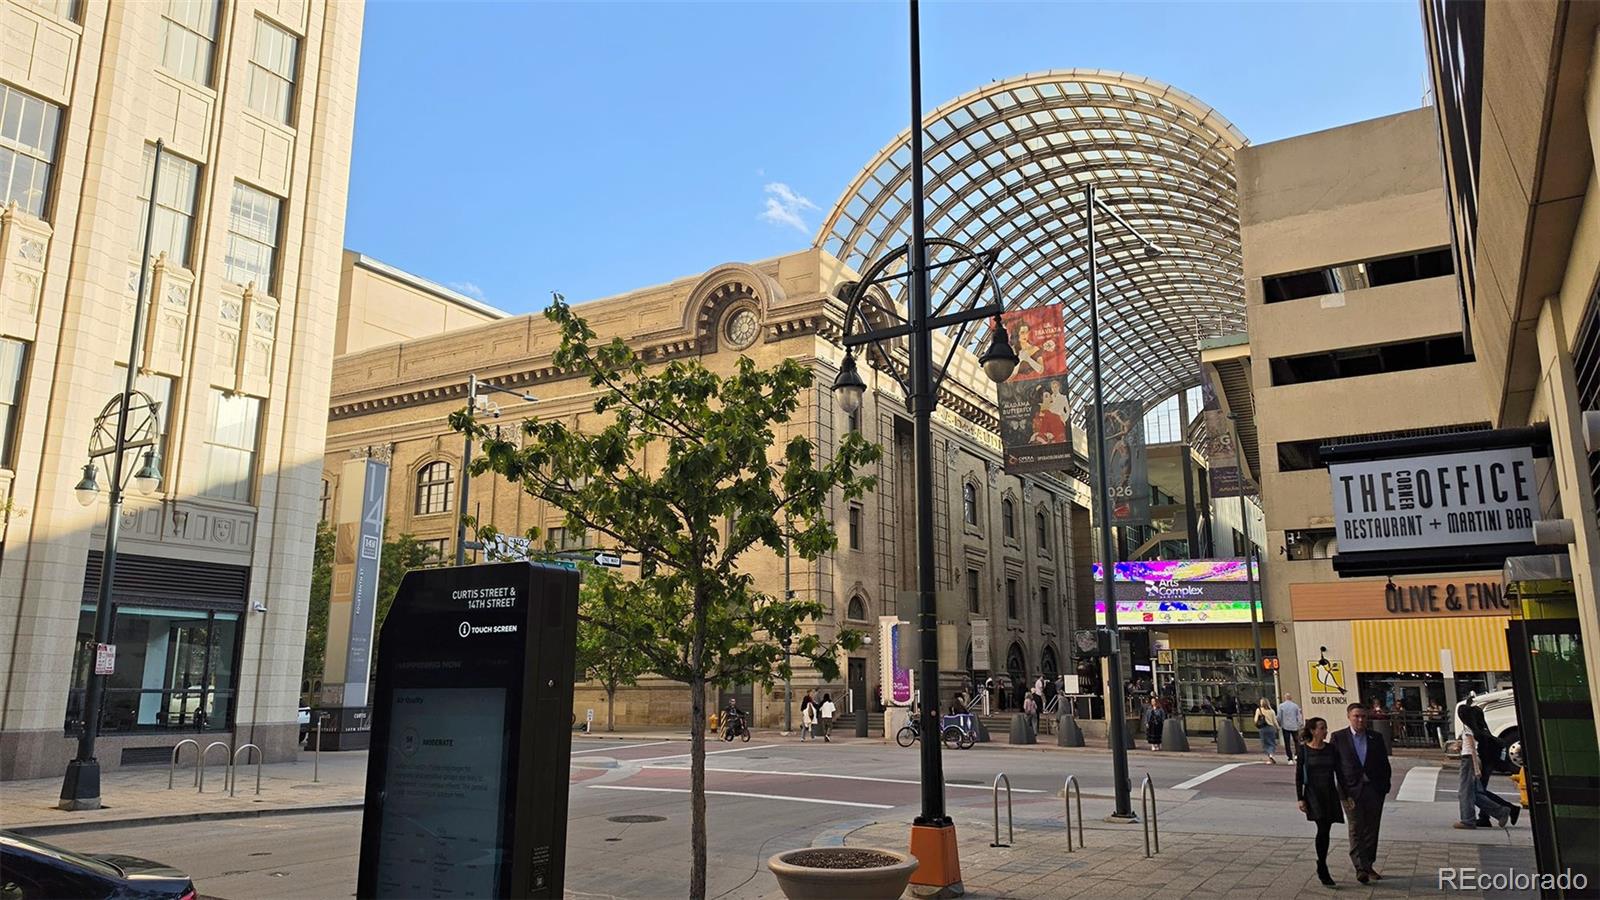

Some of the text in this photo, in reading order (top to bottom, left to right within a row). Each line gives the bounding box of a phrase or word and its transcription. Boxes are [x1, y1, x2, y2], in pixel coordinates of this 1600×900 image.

[1002, 406, 1032, 415] BUTTERFLY
[1003, 400, 1030, 409] MADAMA
[1339, 460, 1529, 513] THE CORNER OFFICE
[1343, 514, 1423, 540] RESTAURANT
[1447, 509, 1503, 534] MARTINI
[1505, 507, 1533, 530] BAR
[1158, 579, 1179, 588] Arts
[452, 586, 516, 600] CURTIS STREET &
[1158, 585, 1204, 598] Complex
[1385, 582, 1510, 613] OLIVE & FINC
[468, 597, 516, 609] 14TH STREET
[471, 624, 518, 634] TOUCH SCREEN
[1311, 696, 1348, 705] OLIVE & FINCH
